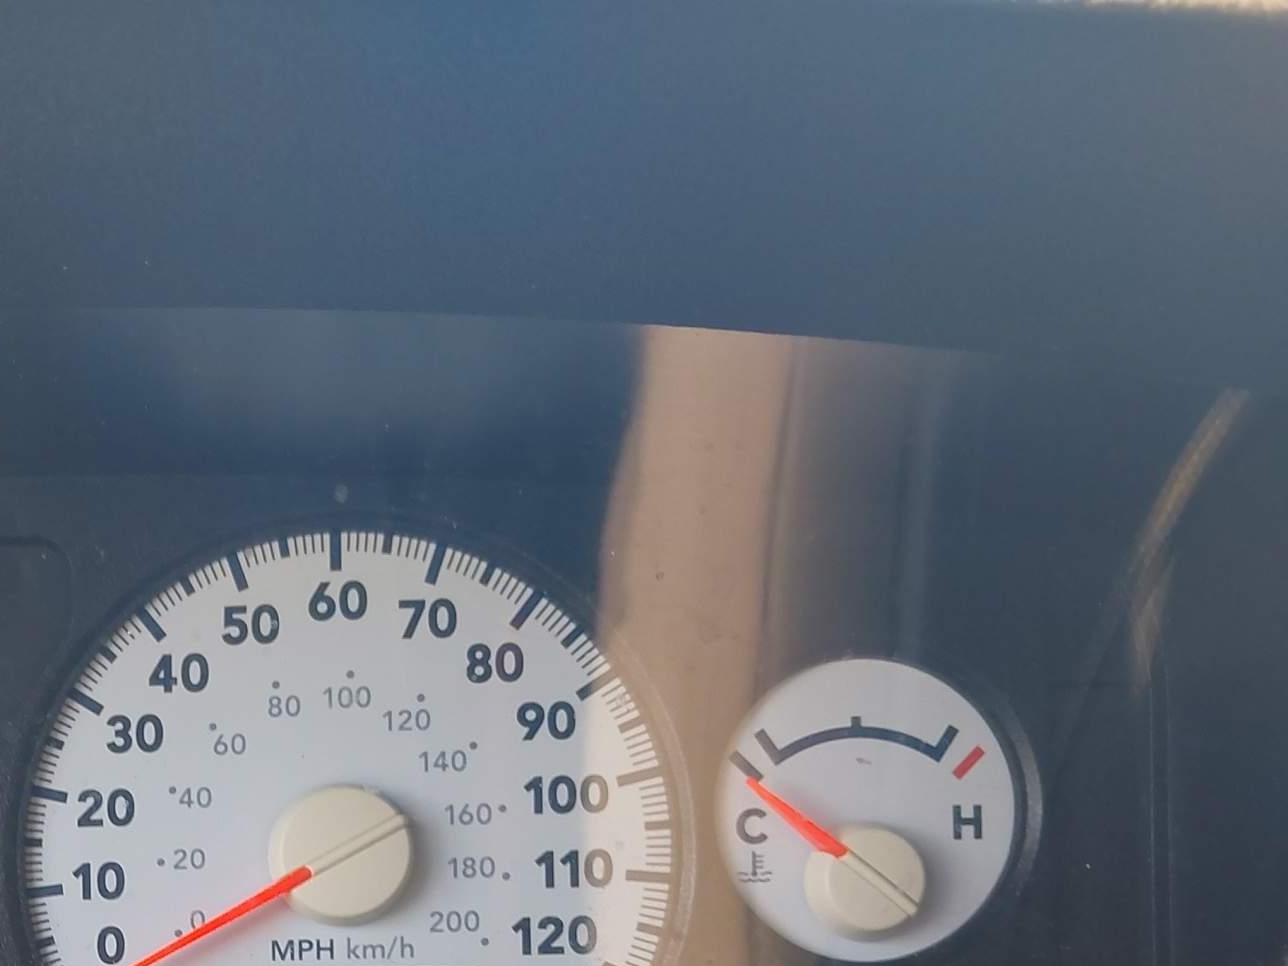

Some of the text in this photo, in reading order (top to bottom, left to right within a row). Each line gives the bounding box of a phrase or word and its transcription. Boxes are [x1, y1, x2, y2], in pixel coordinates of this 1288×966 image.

[308, 581, 368, 621] 60
[398, 599, 457, 639] 70
[222, 604, 280, 644] 50
[149, 653, 209, 693] 40
[466, 643, 524, 683] 80
[267, 695, 301, 718] 80
[322, 686, 372, 709] 100
[106, 714, 164, 754] 30
[382, 709, 431, 732] 120
[516, 701, 576, 741] 90
[213, 734, 247, 756] 60
[419, 750, 467, 773] 140
[76, 789, 135, 828] 20
[178, 787, 212, 809] 40
[524, 775, 610, 814] 100
[445, 804, 492, 827] 160
[736, 808, 769, 847] C
[952, 805, 984, 840] H
[173, 849, 206, 871] 20
[447, 857, 495, 879] 180
[535, 849, 613, 888] 110
[72, 862, 125, 901] 10
[190, 911, 206, 932] 0
[429, 911, 480, 934] 200
[513, 916, 597, 955] 120
[96, 926, 125, 965] 0
[270, 937, 415, 961] MPH km/h
